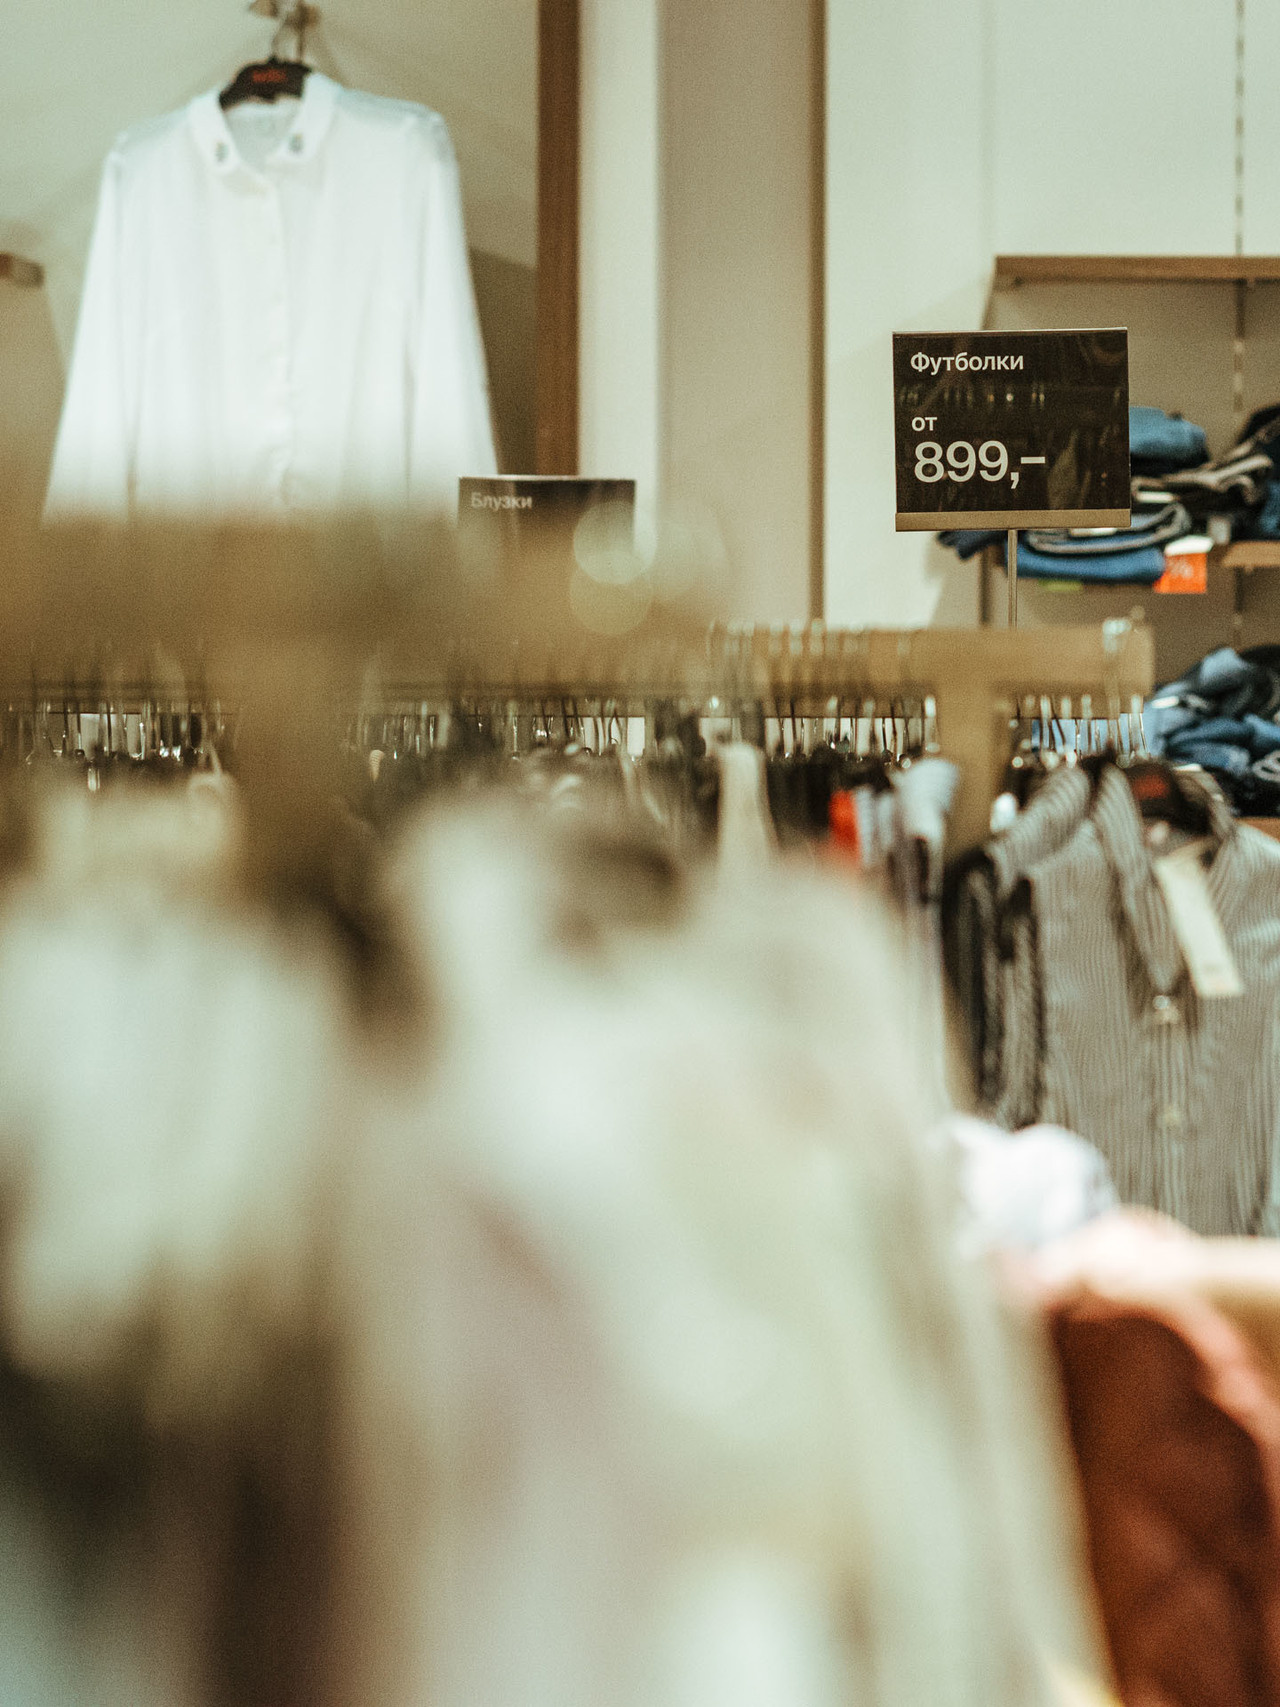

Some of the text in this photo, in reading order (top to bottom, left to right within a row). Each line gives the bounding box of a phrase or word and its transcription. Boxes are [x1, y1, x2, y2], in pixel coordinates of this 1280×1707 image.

[910, 351, 1024, 376] Футболки
[911, 416, 938, 432] от
[470, 491, 533, 512] Блузки
